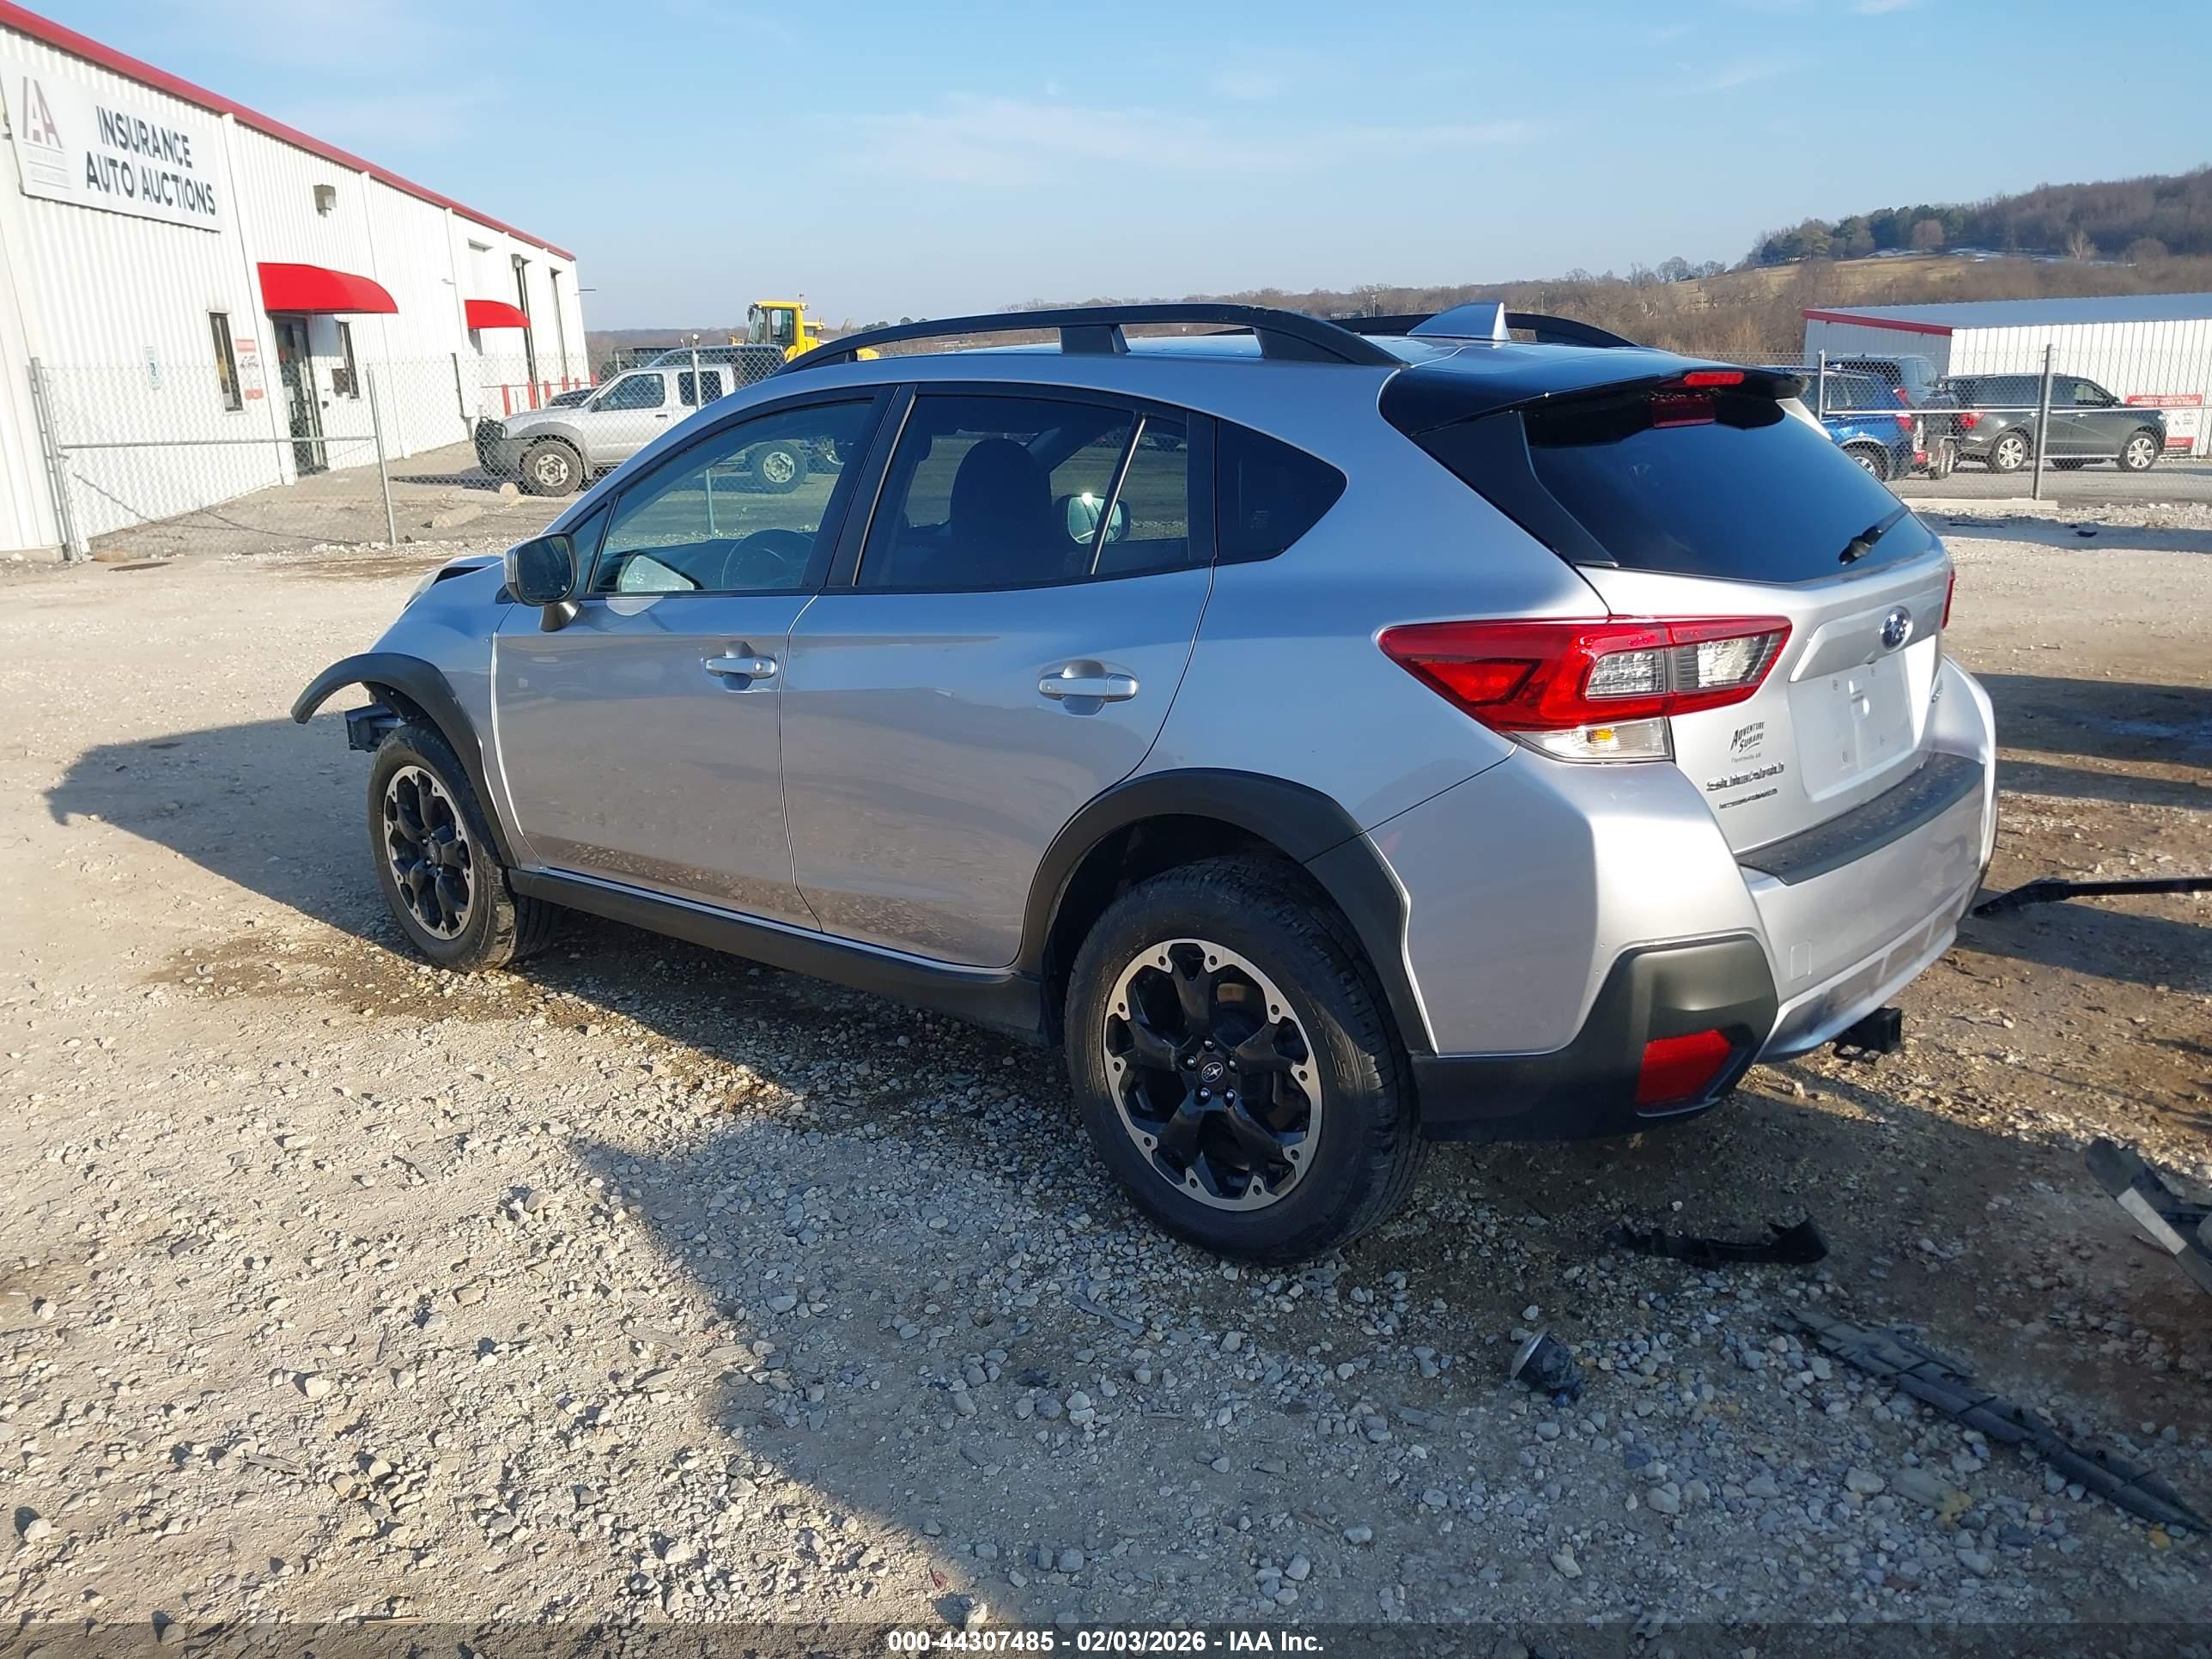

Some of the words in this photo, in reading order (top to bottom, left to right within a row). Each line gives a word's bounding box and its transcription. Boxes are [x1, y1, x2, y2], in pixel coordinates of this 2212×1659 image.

[96, 106, 192, 168] INSURANCE
[87, 151, 134, 198] AUTO
[141, 166, 216, 216] AUCTIONS
[1738, 732, 1764, 753] SUBARU
